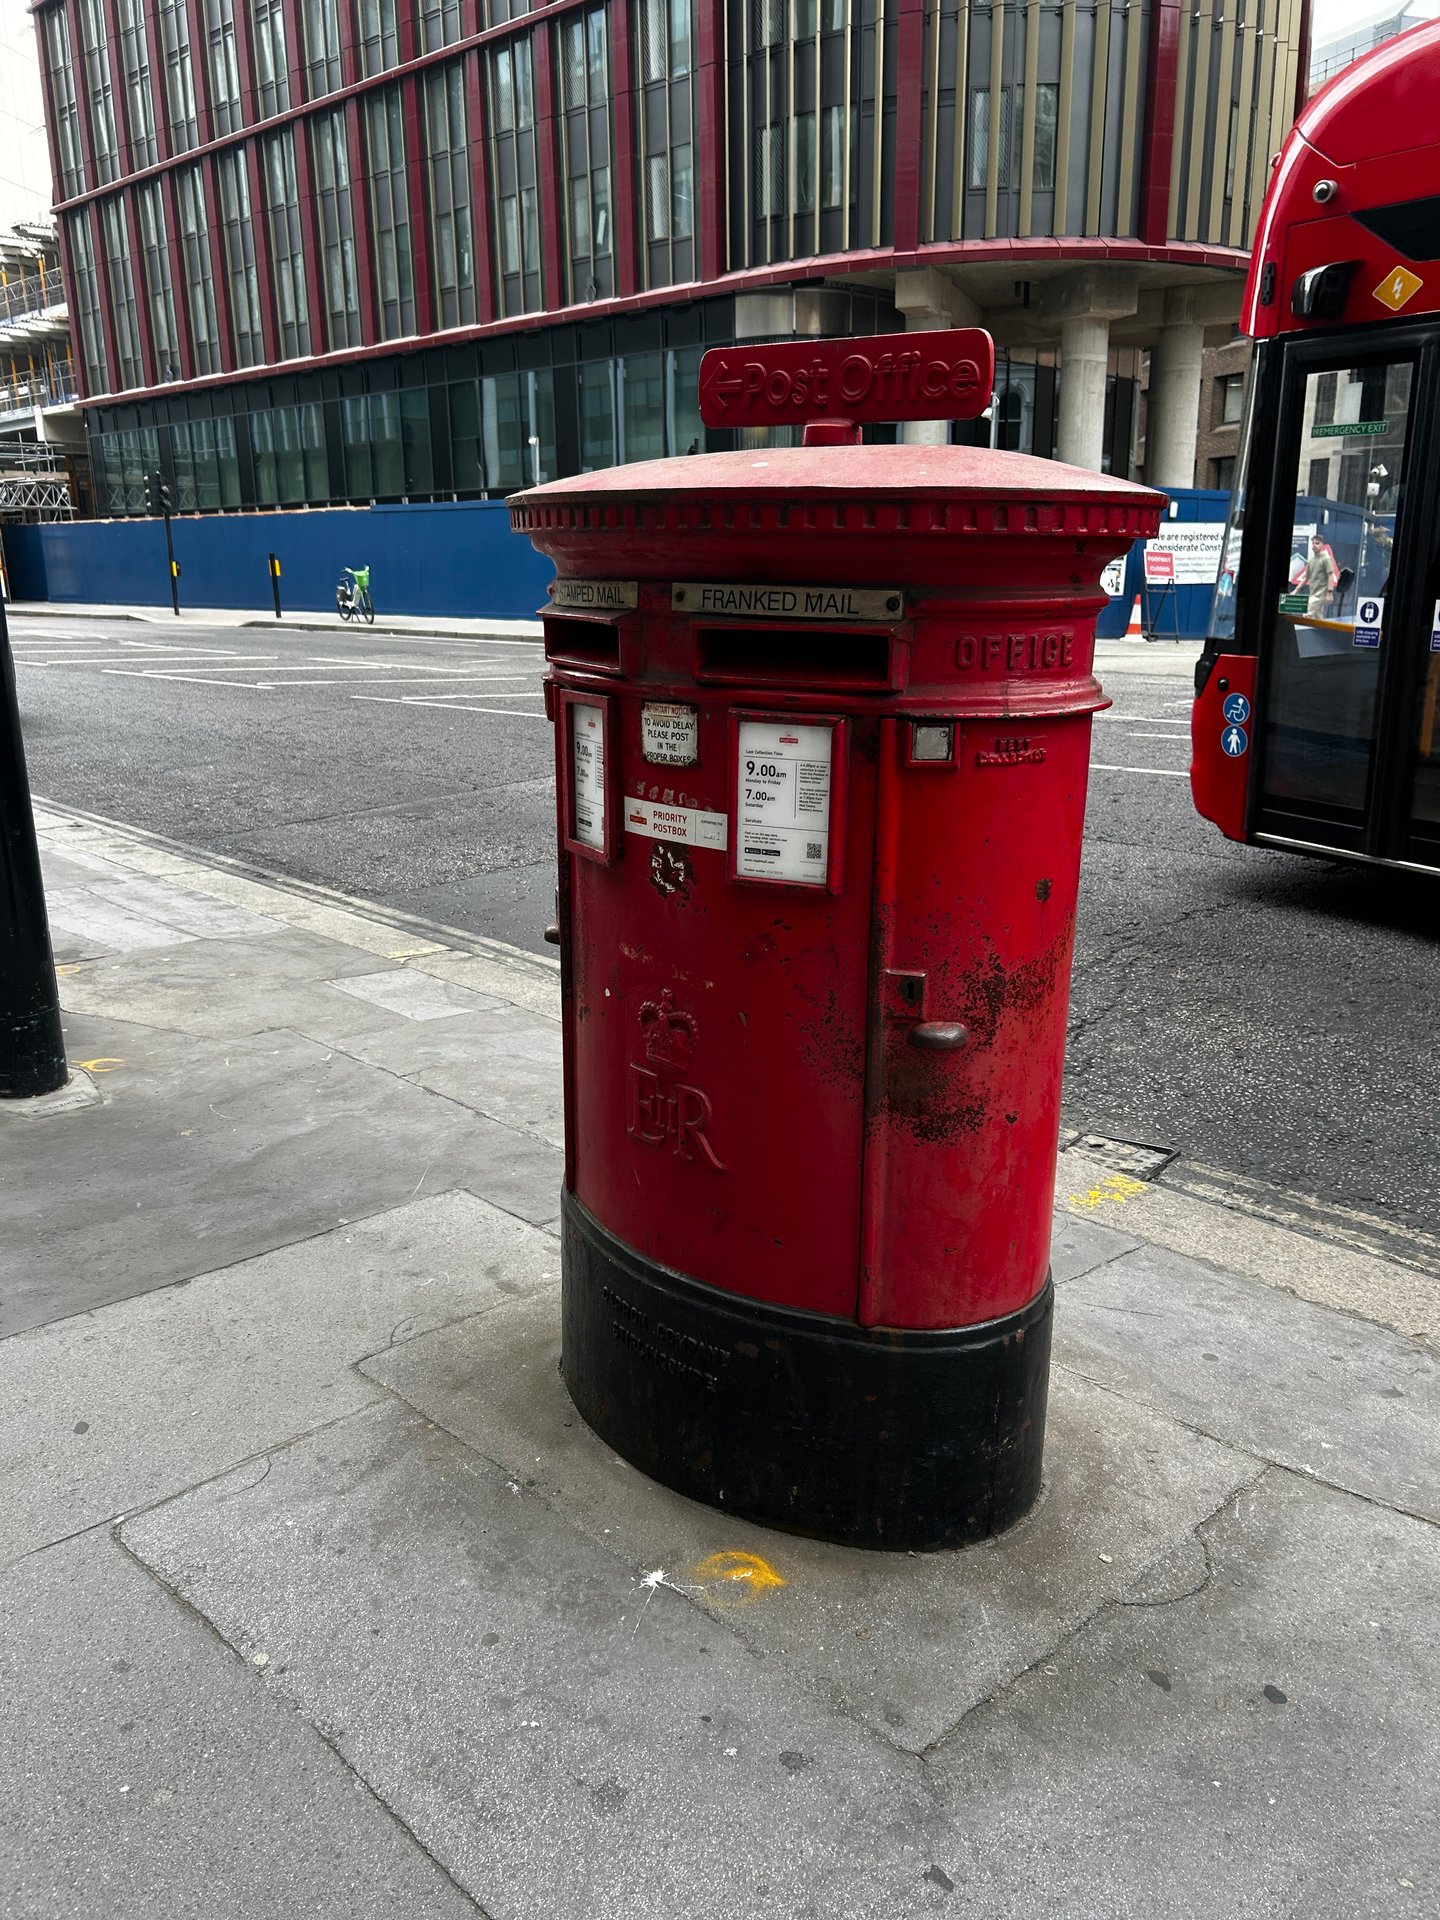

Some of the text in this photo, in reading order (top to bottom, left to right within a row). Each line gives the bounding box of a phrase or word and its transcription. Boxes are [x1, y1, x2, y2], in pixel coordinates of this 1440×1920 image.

[743, 350, 981, 407] Post Office
[1319, 424, 1367, 436] EMERGENCY
[1367, 423, 1387, 433] EXIT
[1180, 533, 1219, 543] registered
[1152, 543, 1198, 552] Considerate
[1149, 565, 1171, 573] CLOSED
[559, 585, 625, 604] STAMPED MAIL
[701, 589, 859, 615] FRANKED MAIL
[955, 632, 1074, 668] OFFICE
[644, 717, 695, 730] TO AVOID DELAY
[648, 729, 689, 742] PLEASE POST
[657, 742, 678, 752] IN THE
[646, 751, 692, 764] PROPER BOXES
[746, 761, 786, 778] 9.00am
[745, 788, 776, 801] 7.00am
[653, 810, 688, 825] PRIORITY
[653, 822, 687, 837] POSTBOX
[603, 1285, 732, 1368] CARRON COMPANY
